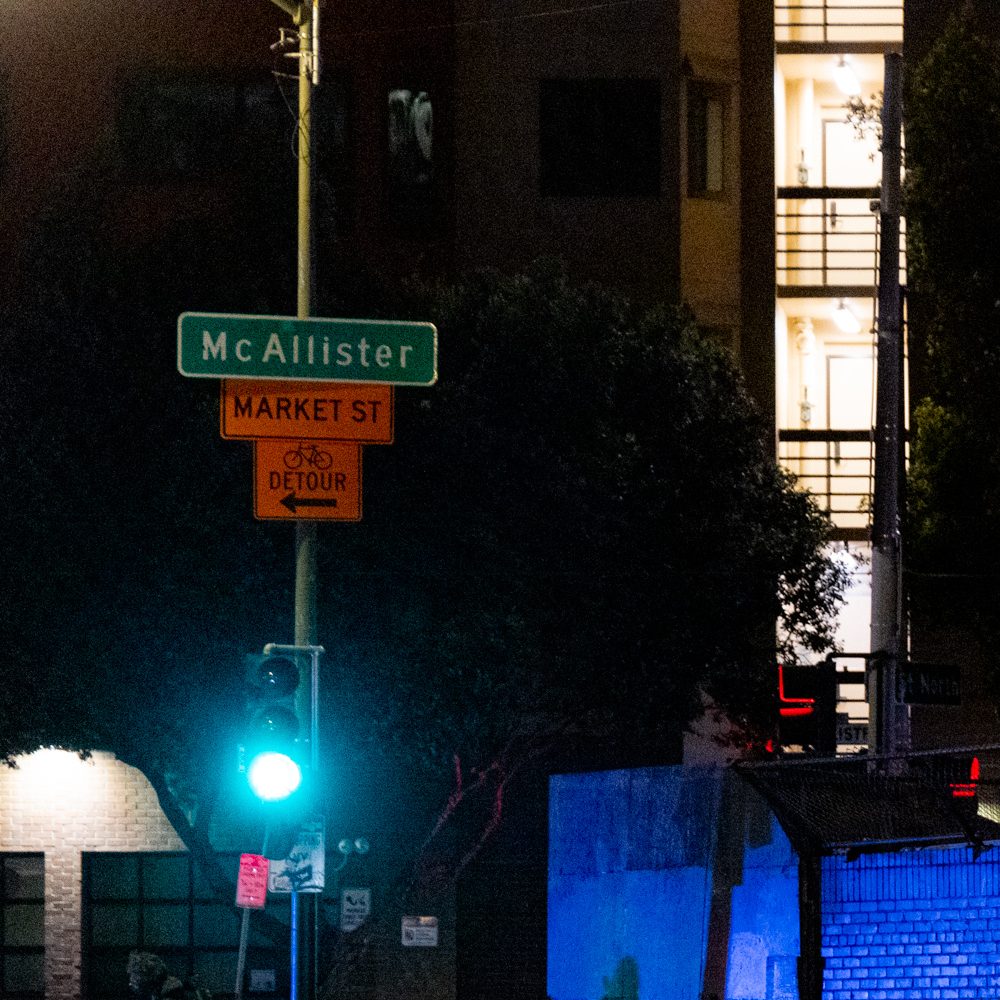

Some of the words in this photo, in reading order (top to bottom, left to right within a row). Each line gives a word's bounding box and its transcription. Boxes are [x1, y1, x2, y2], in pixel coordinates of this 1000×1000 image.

[202, 331, 413, 368] McAllister
[234, 396, 341, 422] MARKET
[351, 400, 382, 424] ST
[269, 471, 347, 491] DETOUR
